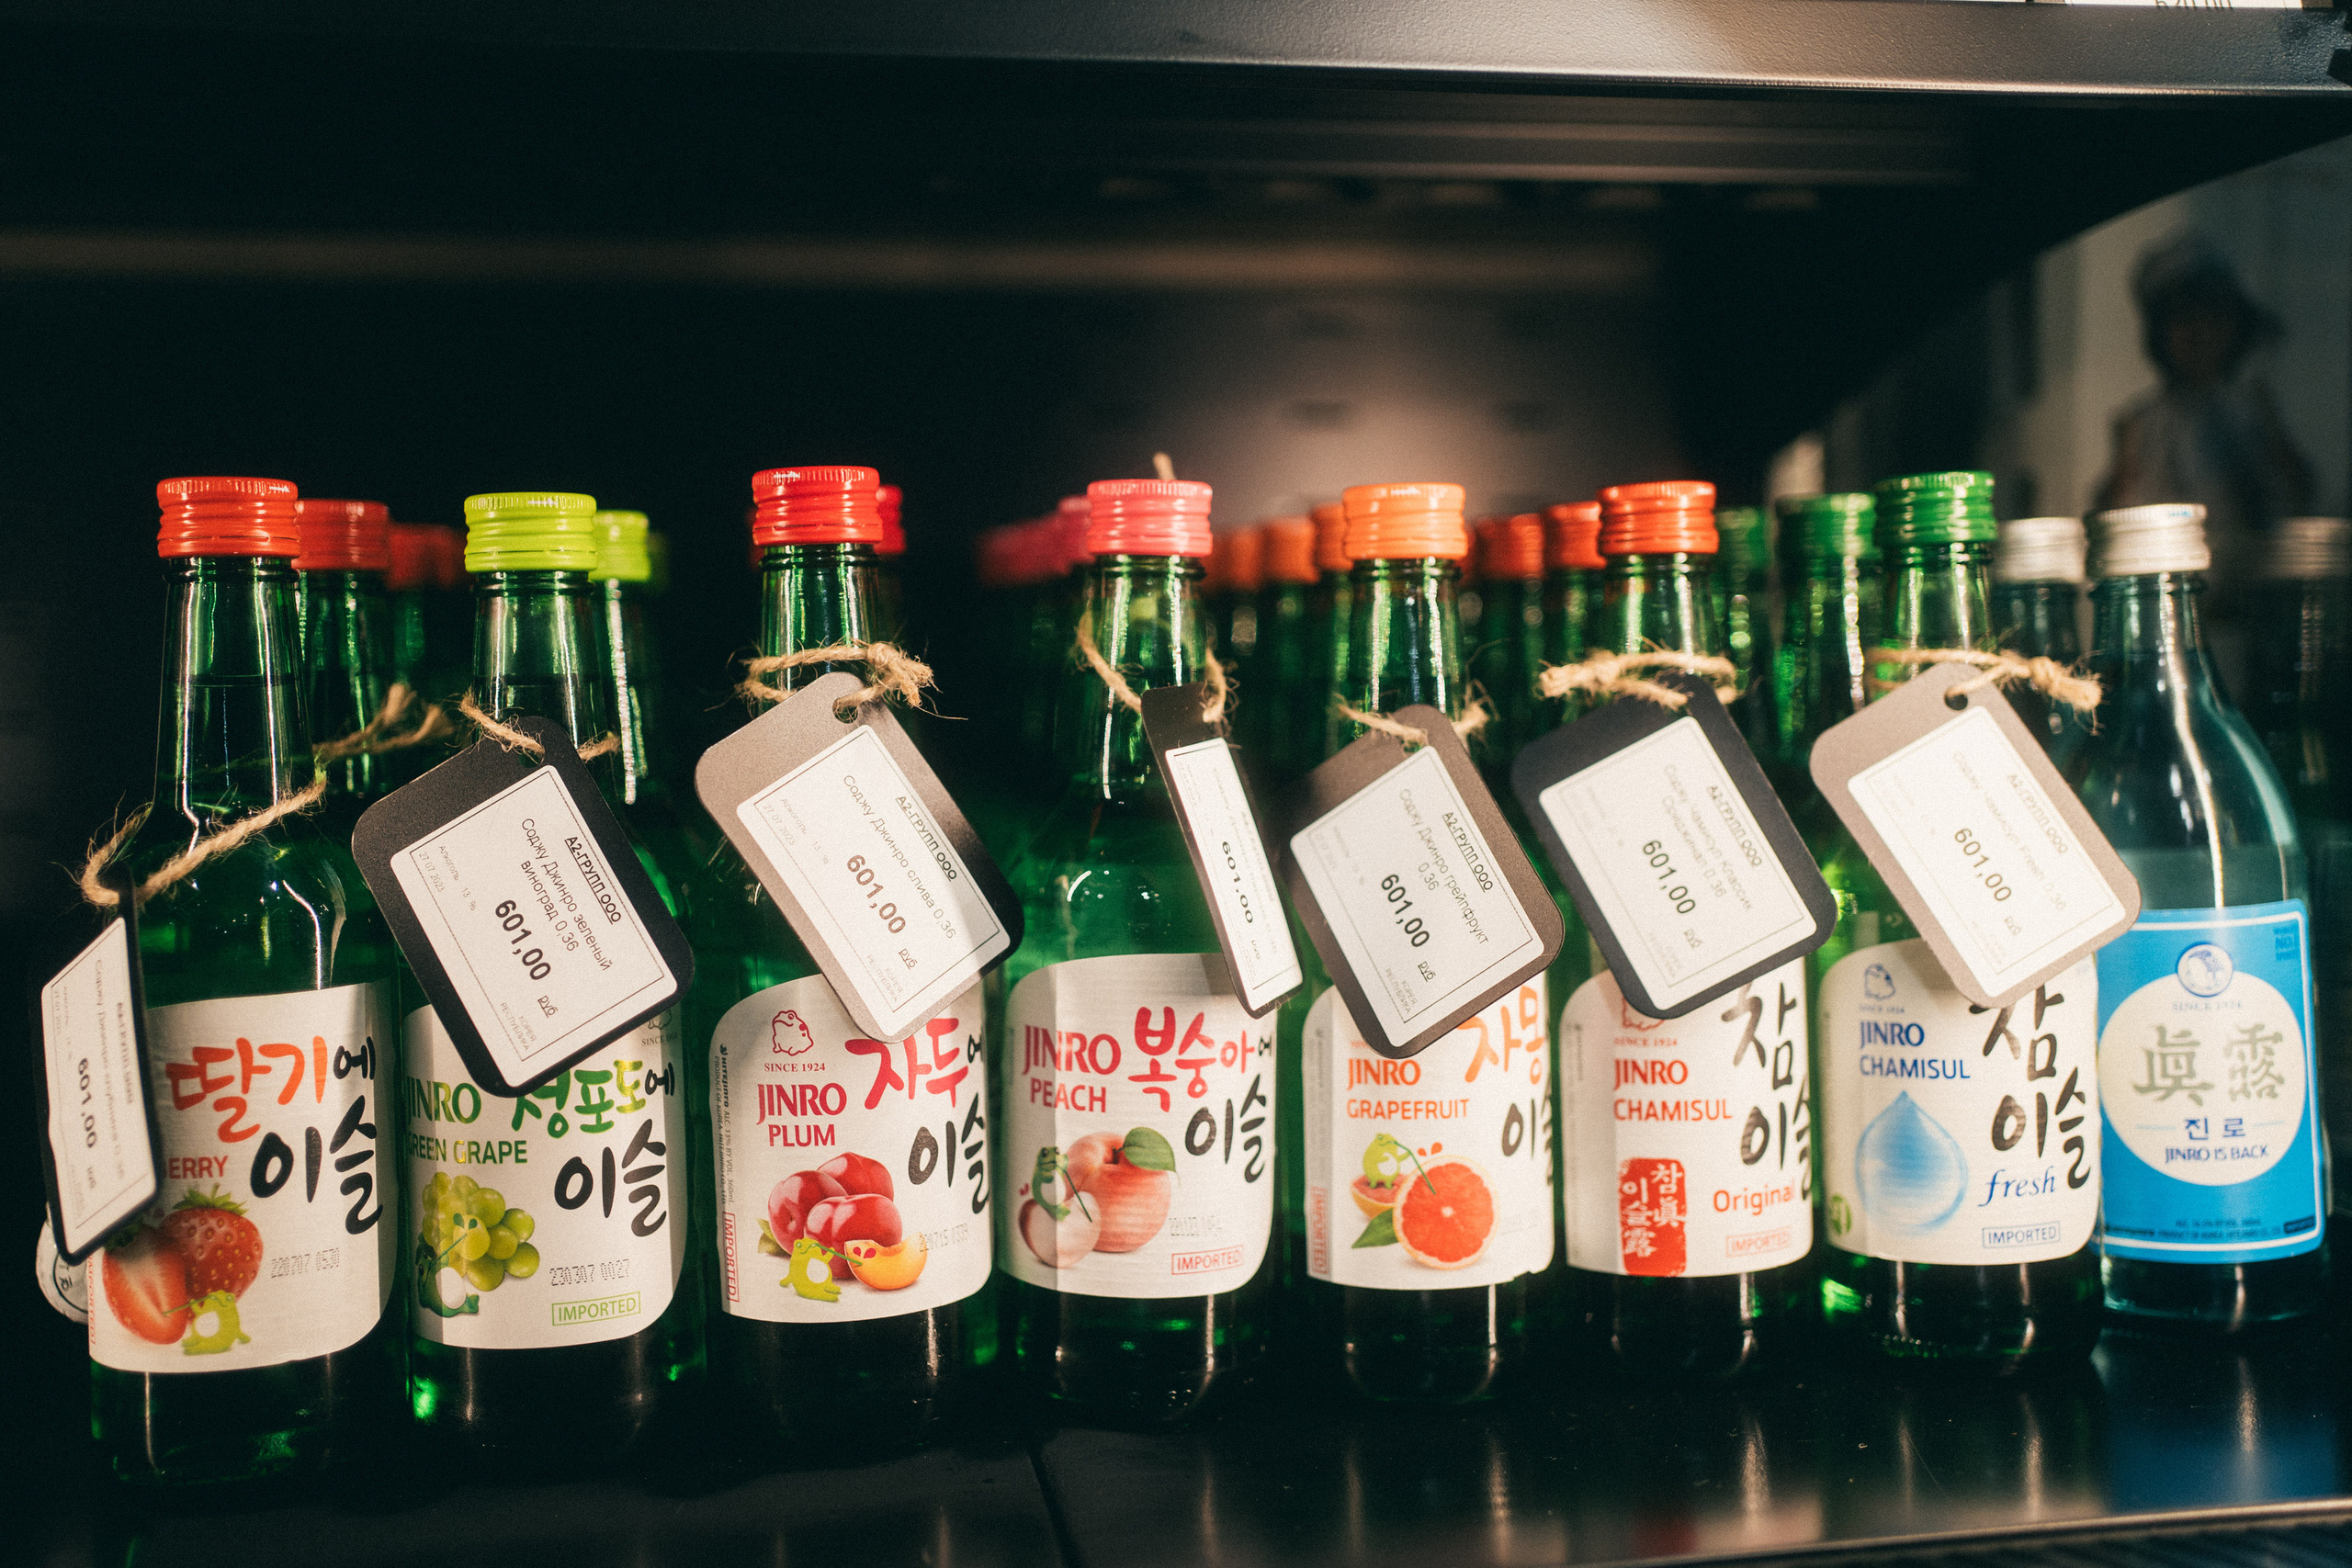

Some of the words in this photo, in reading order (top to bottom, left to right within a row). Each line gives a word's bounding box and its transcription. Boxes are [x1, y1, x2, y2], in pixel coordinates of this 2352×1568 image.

[843, 775, 874, 816] Соджу
[870, 818, 909, 867] Джинро
[908, 870, 934, 908] слива
[933, 908, 956, 939] 0,36
[898, 797, 939, 853] А2-ГРУПП
[936, 852, 956, 881] ООО
[1400, 789, 1423, 827] Соджу
[1418, 828, 1448, 874] Джинро
[1445, 875, 1488, 943] грейпфрукт
[1444, 813, 1478, 865] А2-ГРУПП
[1472, 864, 1493, 892] ООО
[1955, 829, 2011, 901] 601,00
[439, 846, 458, 881] Алкоголь
[462, 887, 470, 897] 13
[470, 901, 476, 910] %
[522, 818, 548, 859] Соджу
[541, 862, 577, 912] Джинро
[573, 914, 612, 970] зеленый
[565, 837, 605, 895] А2-ГРУПП
[596, 894, 621, 924] ООО
[1223, 841, 1252, 923] 601,00
[1419, 863, 1439, 890] 0,36
[1643, 840, 1696, 914] 601,00
[521, 861, 558, 921] виноград
[555, 920, 579, 951] 0,36
[847, 855, 906, 933] 601,00
[899, 949, 917, 969] руб
[1382, 874, 1430, 947] 601,00
[1418, 962, 1435, 982] руб
[495, 900, 550, 980] 601,00
[537, 995, 558, 1018] руб
[501, 1002, 529, 1050] РЕСПУБЛИКА
[641, 1034, 664, 1046] SINCE
[1023, 1024, 1122, 1076] JINRO
[1860, 1021, 1925, 1049] JINRO
[165, 1035, 377, 1143] 딸기에
[763, 1063, 798, 1073] SINCE
[801, 1062, 826, 1073] 1924
[1030, 1077, 1106, 1112] PEACH
[1347, 1059, 1421, 1090] JINRO
[1612, 1059, 1689, 1091] JINRO
[1860, 1055, 1971, 1079] CHAMISUL
[79, 1058, 96, 1148] 601,00
[405, 1076, 481, 1129] JINRO
[756, 1082, 847, 1125] JINRO
[1185, 1074, 1266, 1183] 이슬
[1346, 1099, 1470, 1120] GRAPEFRUIT
[1613, 1099, 1733, 1122] CHAMISUL
[1992, 1066, 2090, 1189] 이슬
[407, 1132, 447, 1163] GREEN
[453, 1139, 528, 1165] GRAPE
[768, 1123, 836, 1147] PLUM
[908, 1092, 990, 1214] 이슬
[2165, 1145, 2211, 1164] JINRO
[2214, 1147, 2226, 1161] IS
[2231, 1145, 2269, 1159] BACK
[250, 1095, 383, 1235] 이슬
[554, 1118, 667, 1237] 이슬
[1978, 1166, 2056, 1207] fresh
[1713, 1178, 1795, 1215] Original
[724, 1218, 737, 1296] IMPORTED
[1988, 1226, 2056, 1245] IMPORTED
[549, 1264, 594, 1287] 230307
[600, 1258, 630, 1281] 0027
[558, 1297, 636, 1322] IMPORTED
